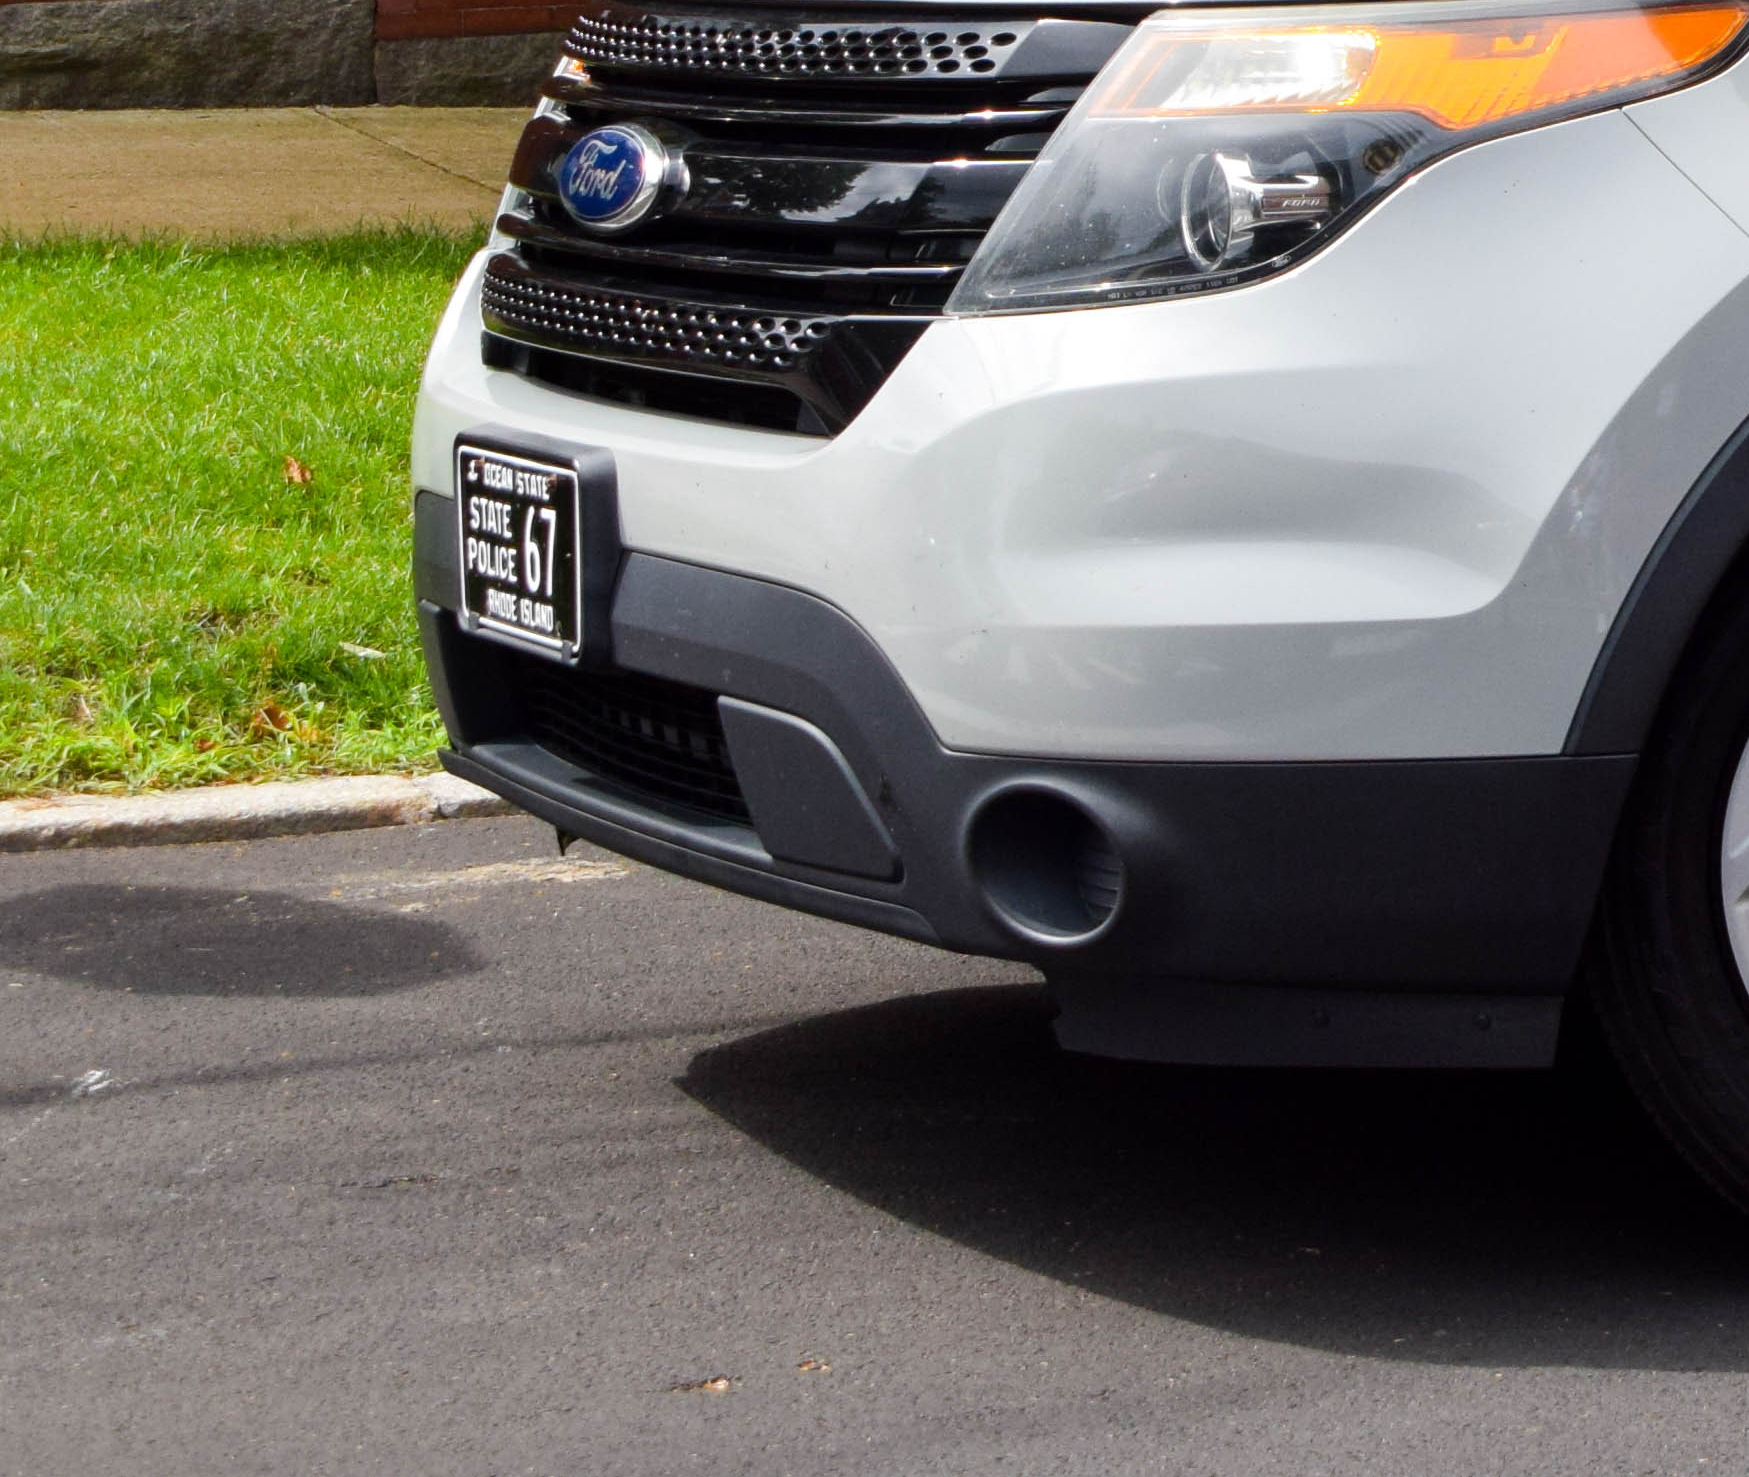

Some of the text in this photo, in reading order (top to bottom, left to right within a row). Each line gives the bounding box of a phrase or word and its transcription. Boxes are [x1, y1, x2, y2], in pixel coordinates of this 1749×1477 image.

[568, 140, 627, 200] Ford
[483, 462, 550, 501] OCEAN STATE
[469, 496, 513, 539] STATE
[467, 537, 518, 583] POLICE
[524, 506, 557, 597] 67
[487, 588, 554, 631] RHODE ISLAND
